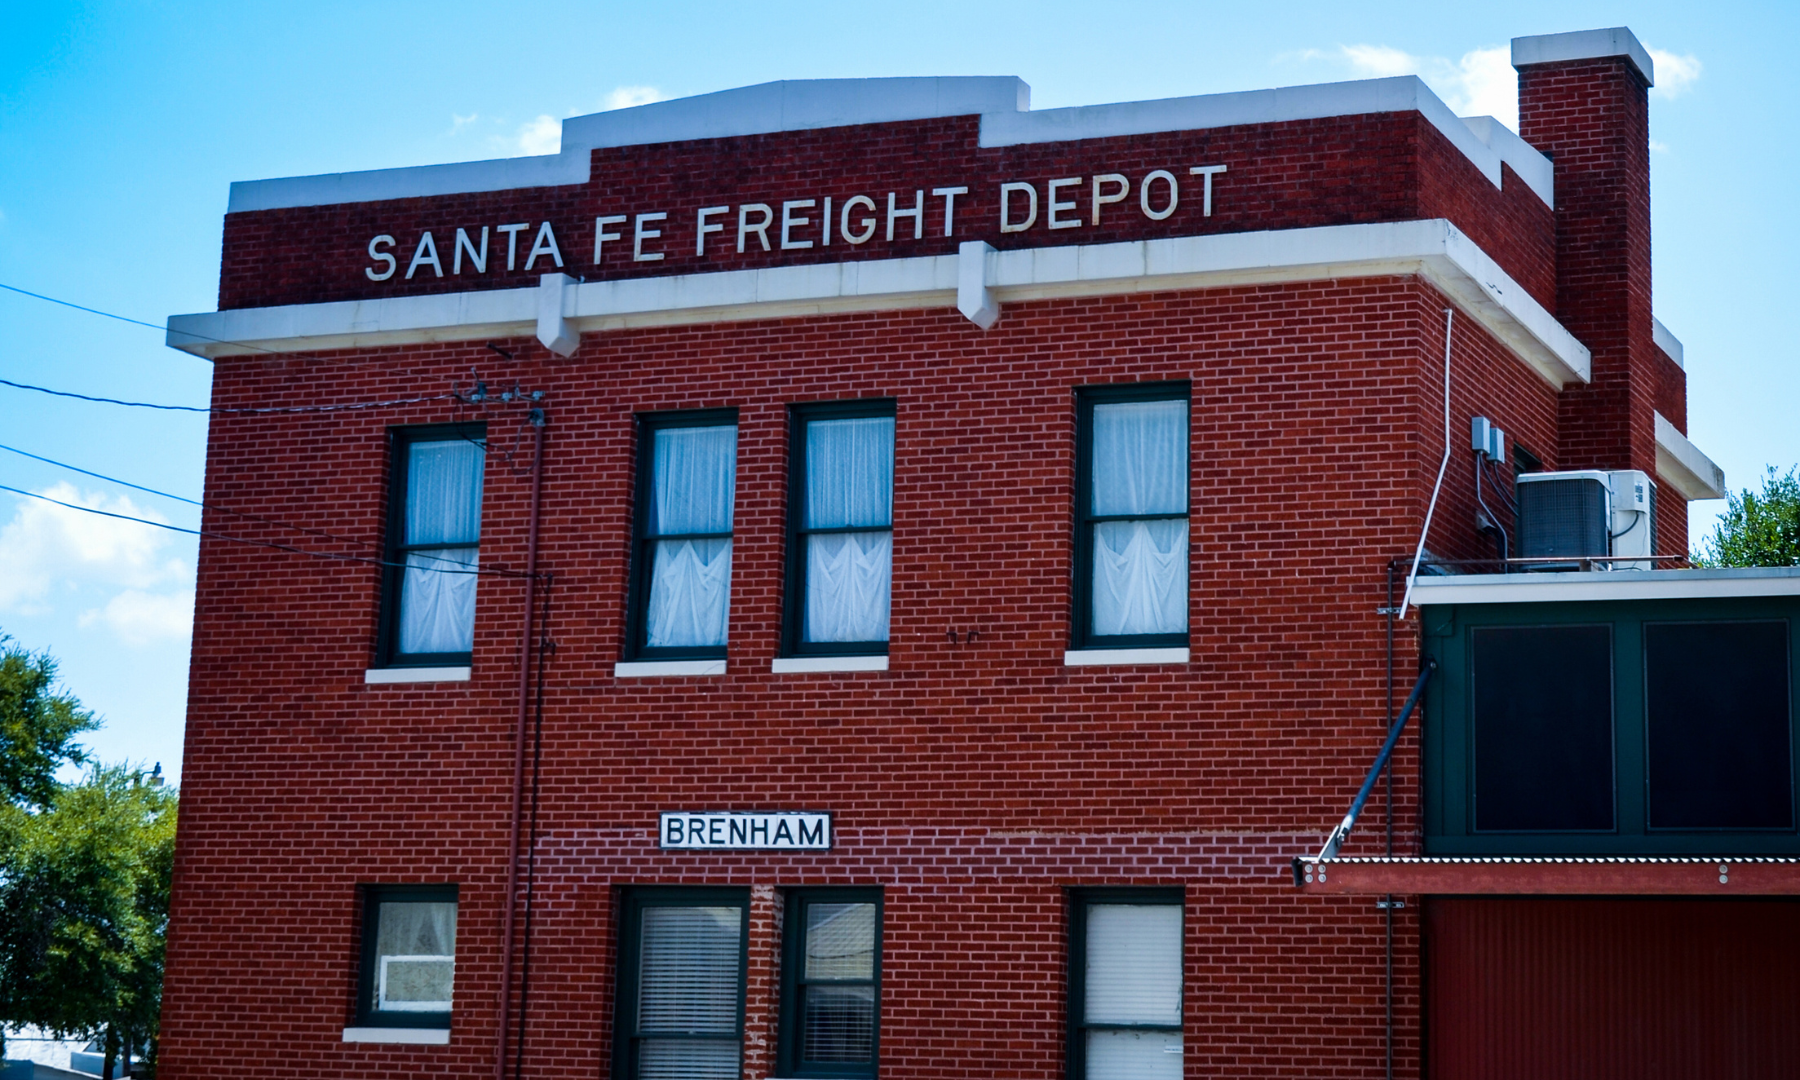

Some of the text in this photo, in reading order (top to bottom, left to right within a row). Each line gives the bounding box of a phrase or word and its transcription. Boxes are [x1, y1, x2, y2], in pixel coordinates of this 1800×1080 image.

[365, 164, 1227, 282] SANTA FE FREIGHT DEPOT
[667, 818, 823, 845] BRENHAM
